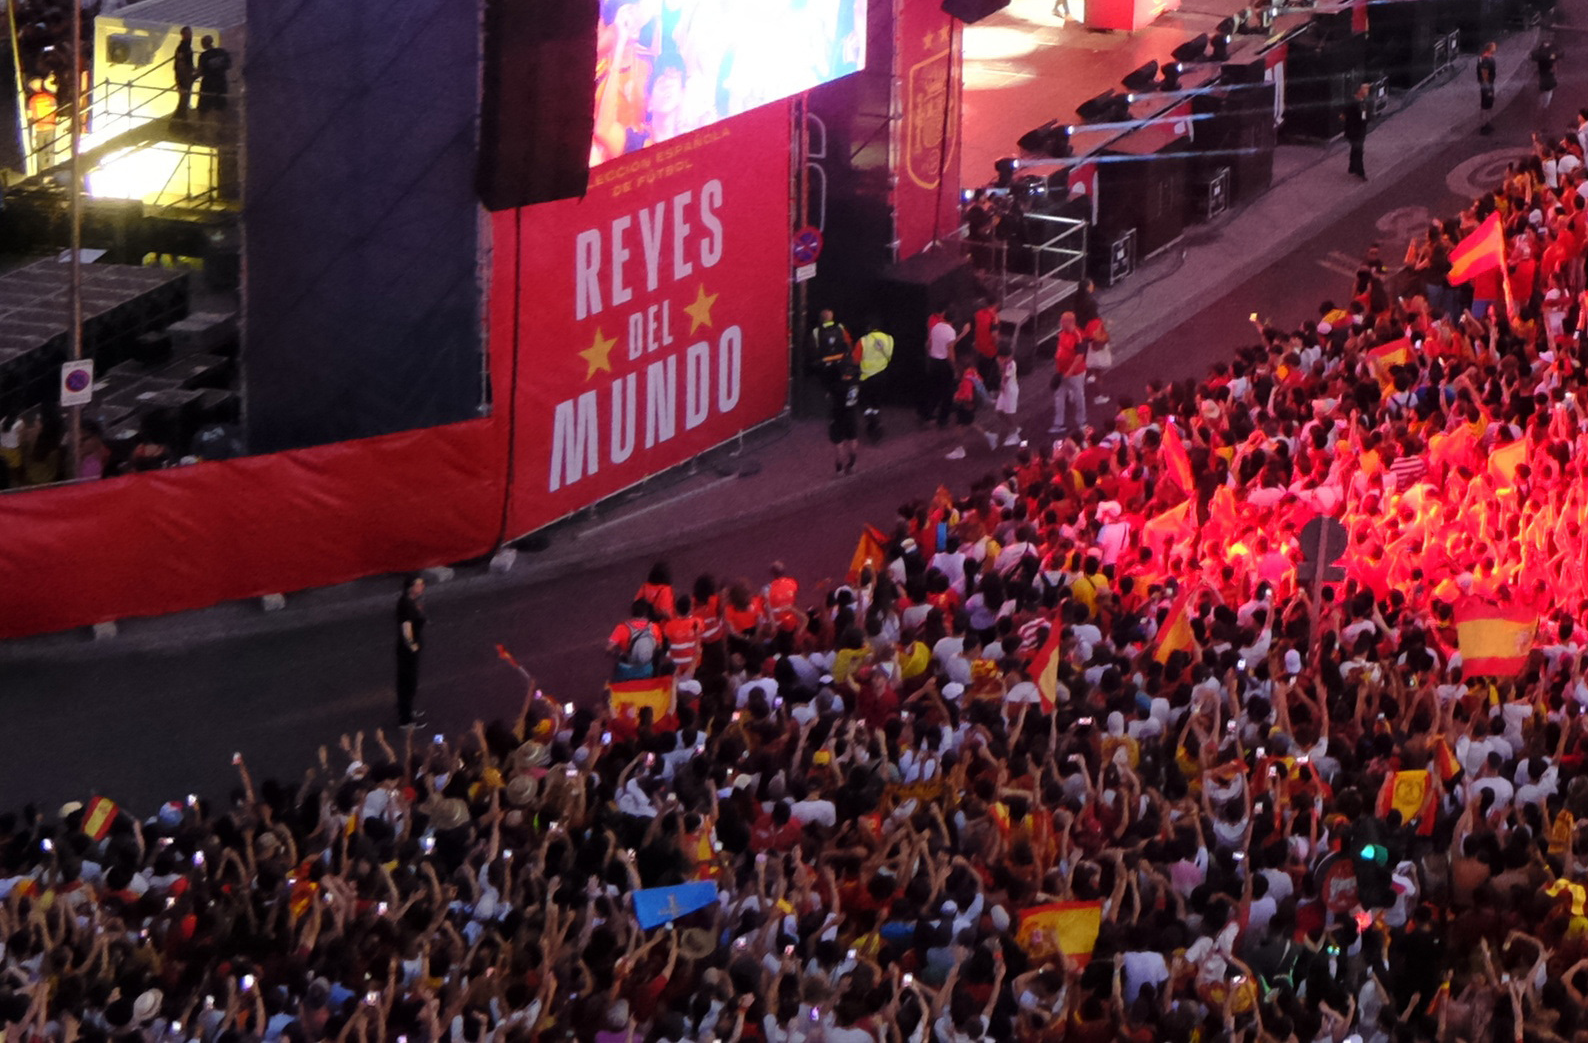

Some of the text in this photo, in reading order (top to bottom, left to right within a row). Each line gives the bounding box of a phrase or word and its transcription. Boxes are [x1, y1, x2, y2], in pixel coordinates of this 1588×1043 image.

[655, 127, 731, 162] ESPAÑOLA
[611, 160, 694, 198] DE FÚTBOL
[576, 179, 723, 322] REYES
[628, 299, 674, 361] DEL
[549, 325, 742, 493] MUNDO
